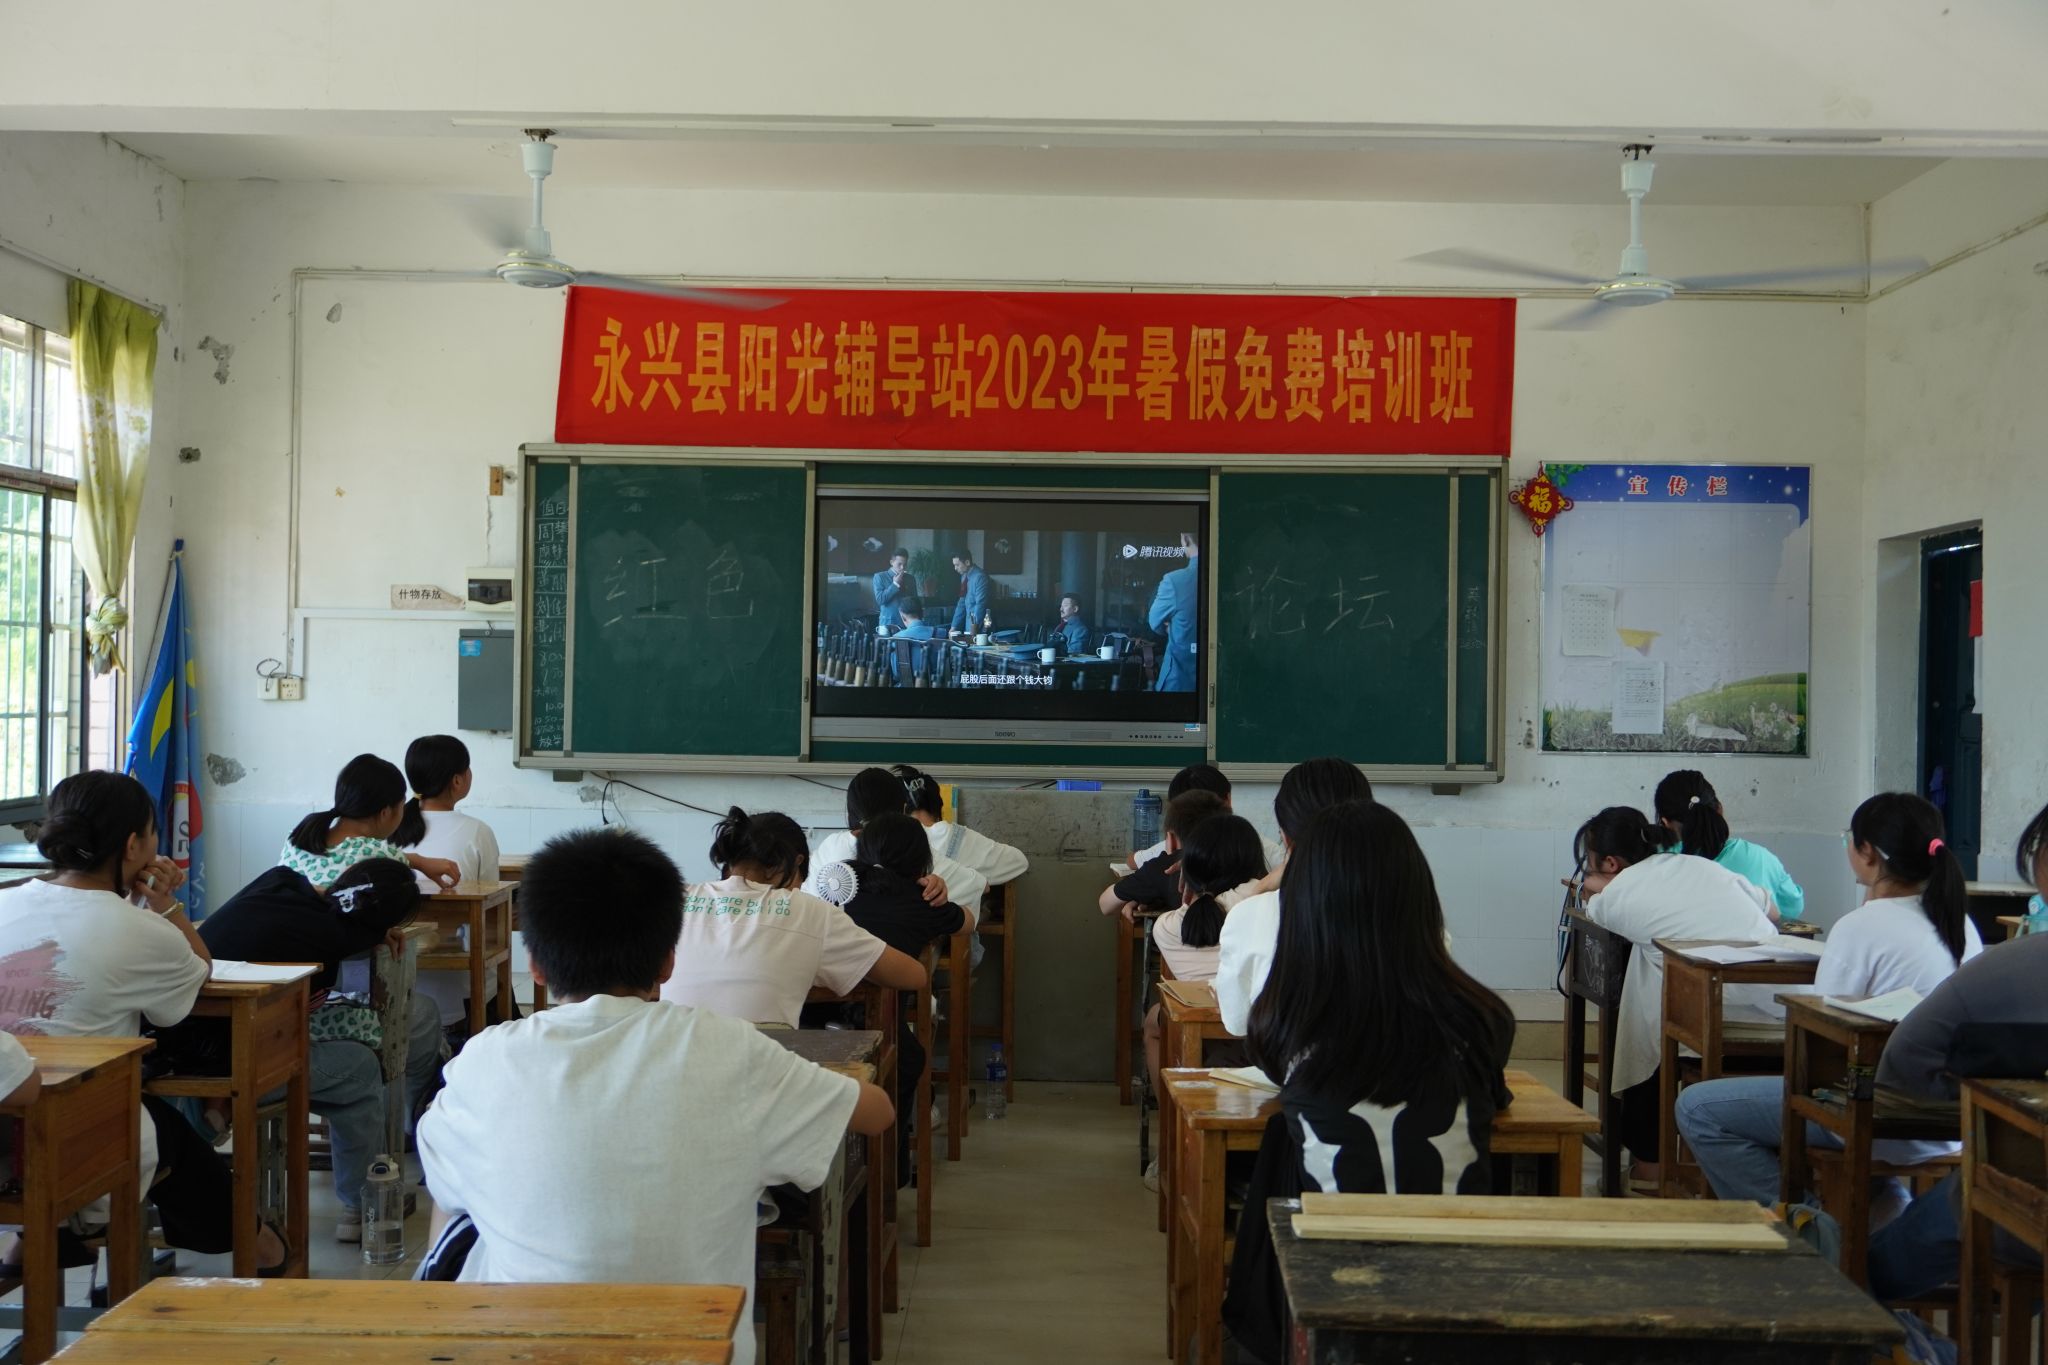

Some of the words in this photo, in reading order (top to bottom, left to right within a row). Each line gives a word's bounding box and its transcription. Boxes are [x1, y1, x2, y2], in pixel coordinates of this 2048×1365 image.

[592, 316, 1475, 425] 永兴县阳光辅导站2023年暑假免费培训班
[1627, 475, 1728, 497] 宣传栏
[539, 498, 568, 516] 值日
[1528, 486, 1552, 514] 福
[1139, 545, 1186, 558] 腾讯视频
[398, 588, 443, 600] 什物存放
[603, 549, 754, 628] 红色
[1235, 564, 1395, 640] 论坛
[775, 907, 791, 916] do
